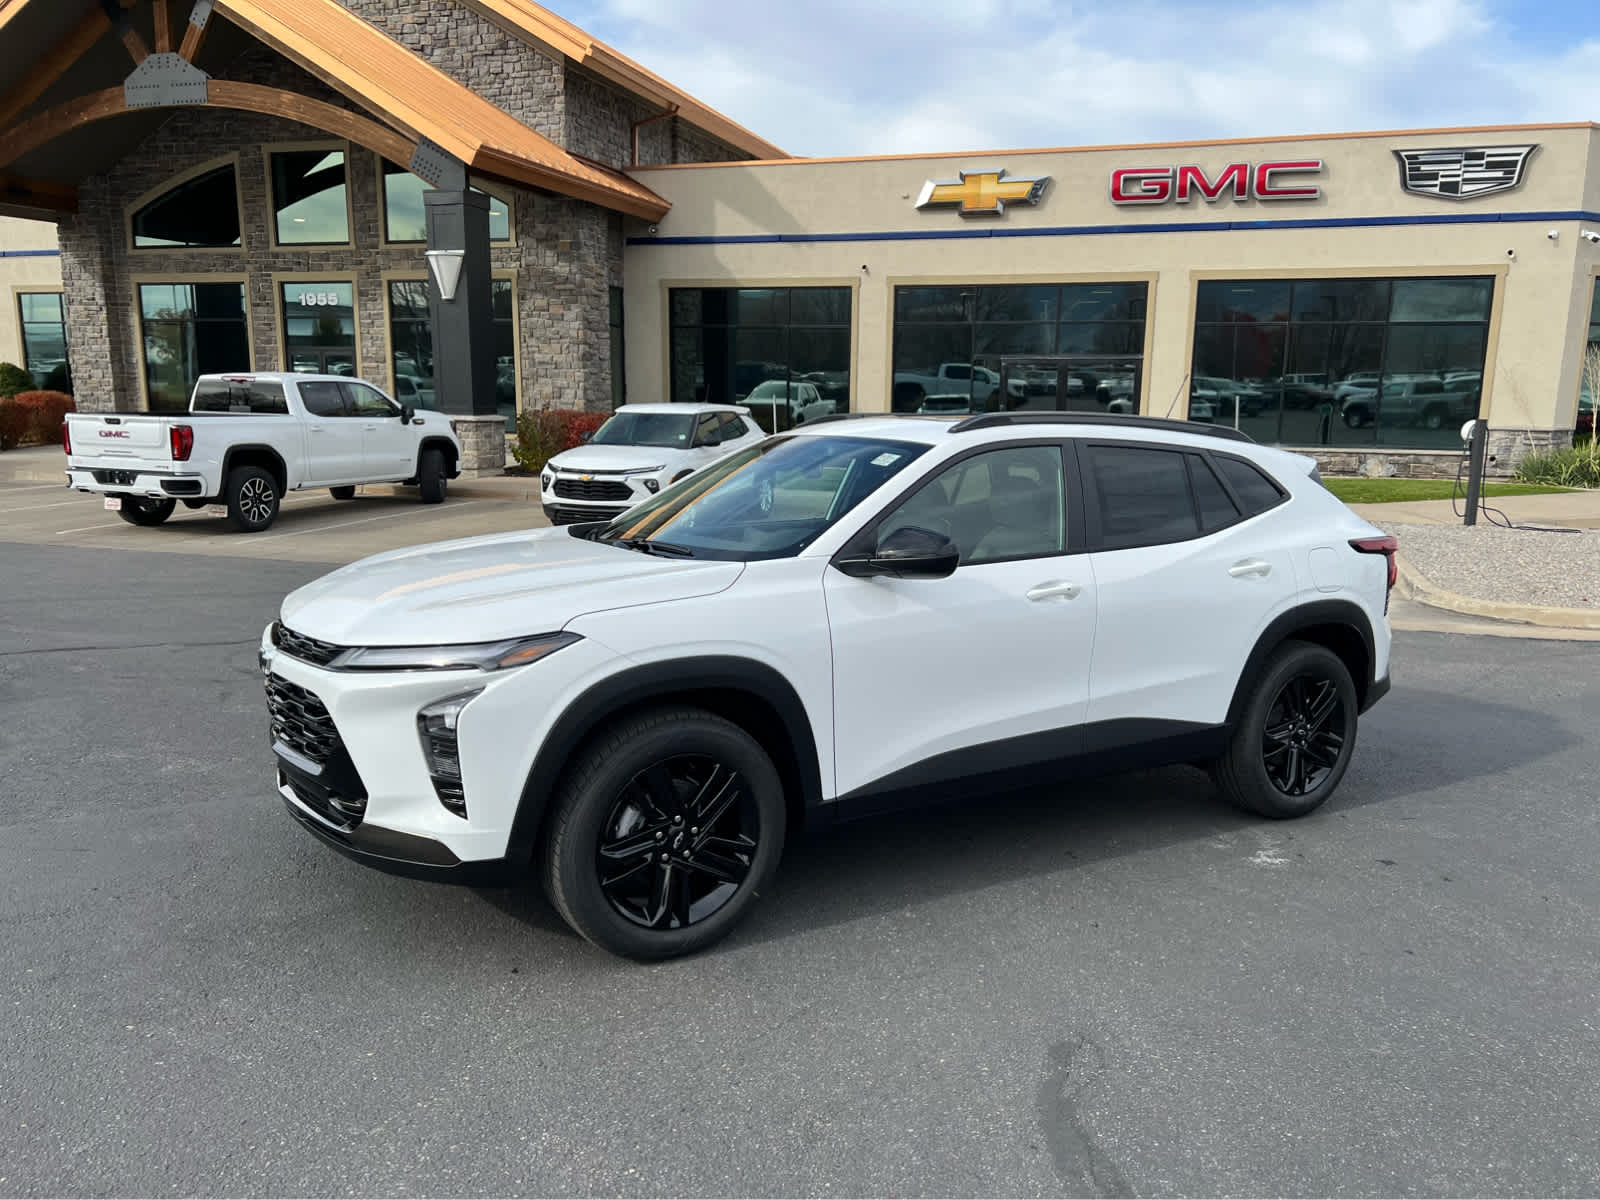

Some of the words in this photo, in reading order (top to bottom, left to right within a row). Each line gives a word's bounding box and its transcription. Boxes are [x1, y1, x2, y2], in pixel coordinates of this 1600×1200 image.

[1110, 159, 1323, 205] GMC
[298, 292, 338, 306] 1955
[98, 430, 130, 439] GMC
